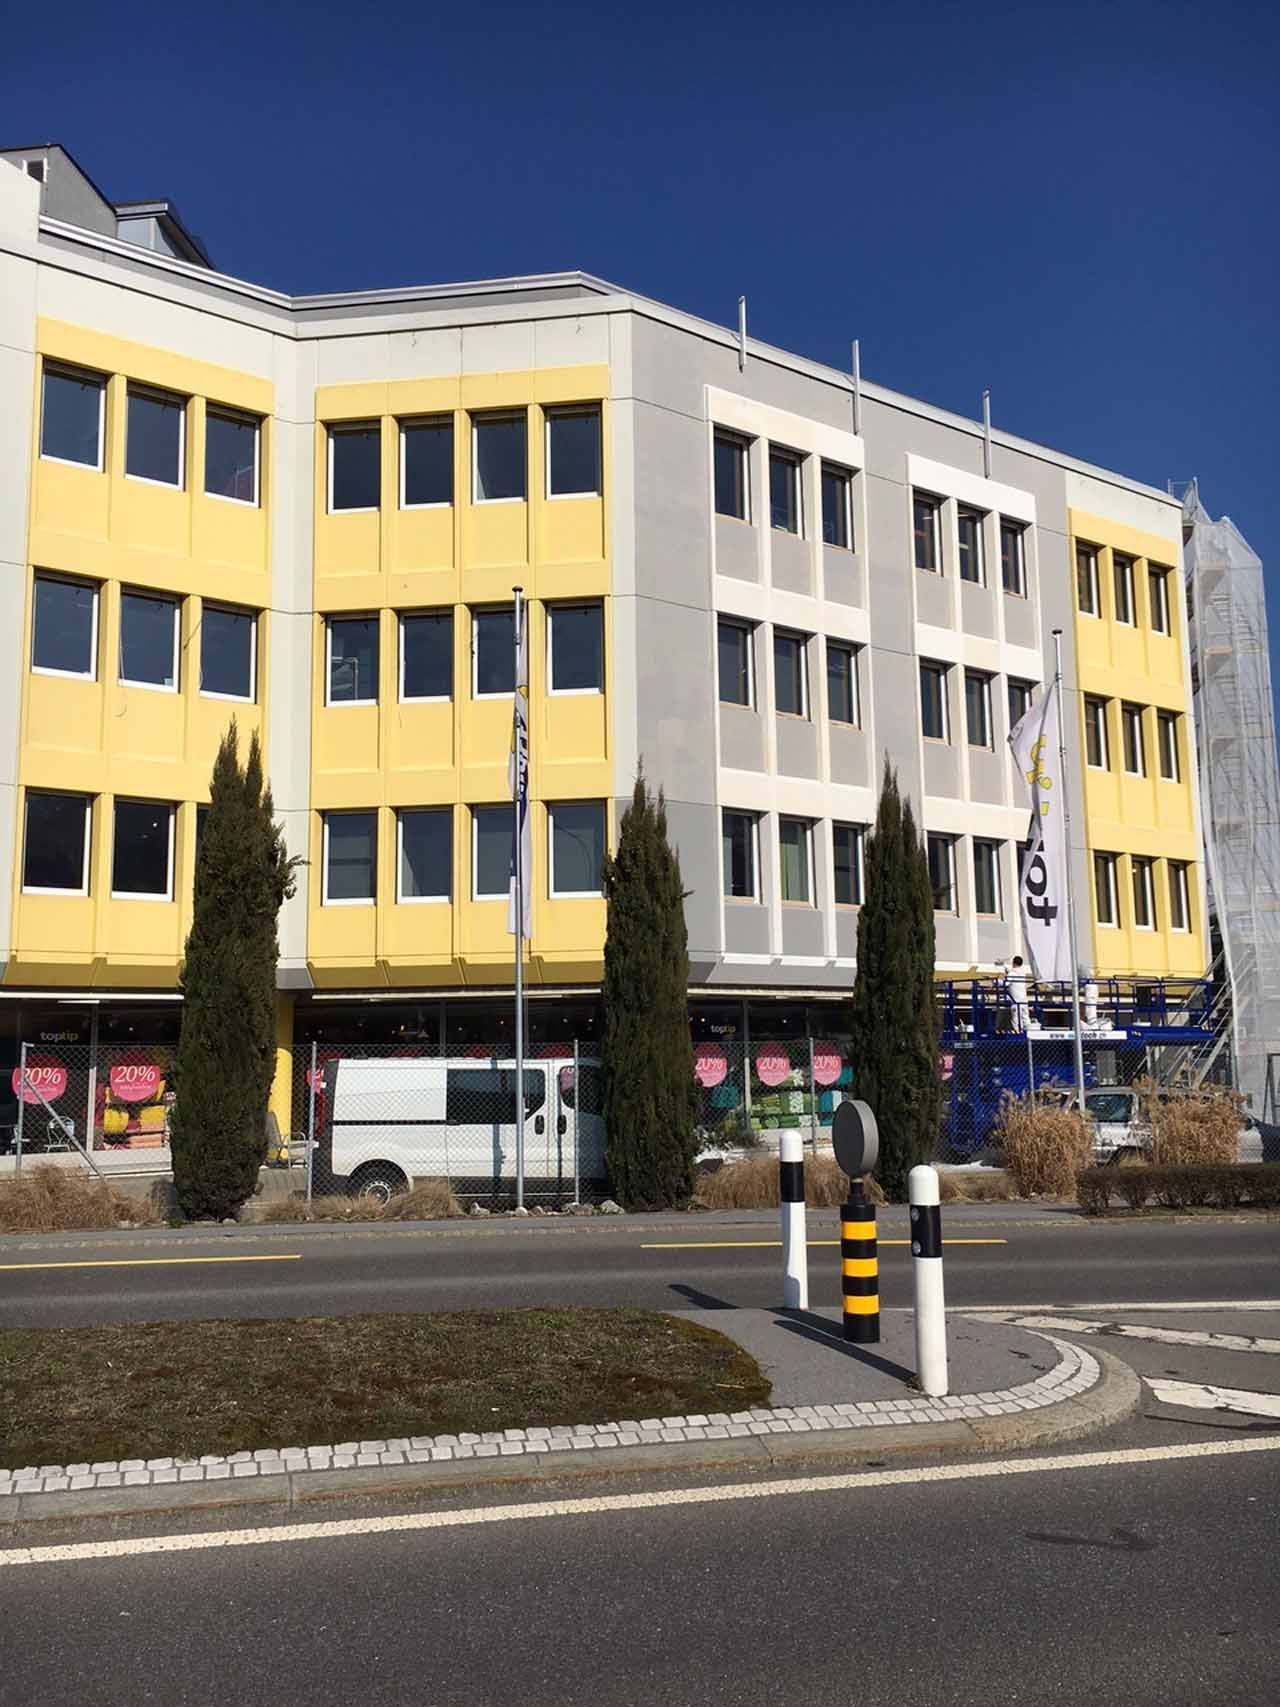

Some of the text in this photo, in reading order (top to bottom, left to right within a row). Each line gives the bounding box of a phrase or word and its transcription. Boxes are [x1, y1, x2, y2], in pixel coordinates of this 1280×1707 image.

[710, 1024, 736, 1035] toptip
[40, 1031, 79, 1042] toptip
[695, 1058, 723, 1071] 20%
[759, 1058, 786, 1071] 20%
[813, 1056, 839, 1070] 20%
[114, 1065, 156, 1083] 20%
